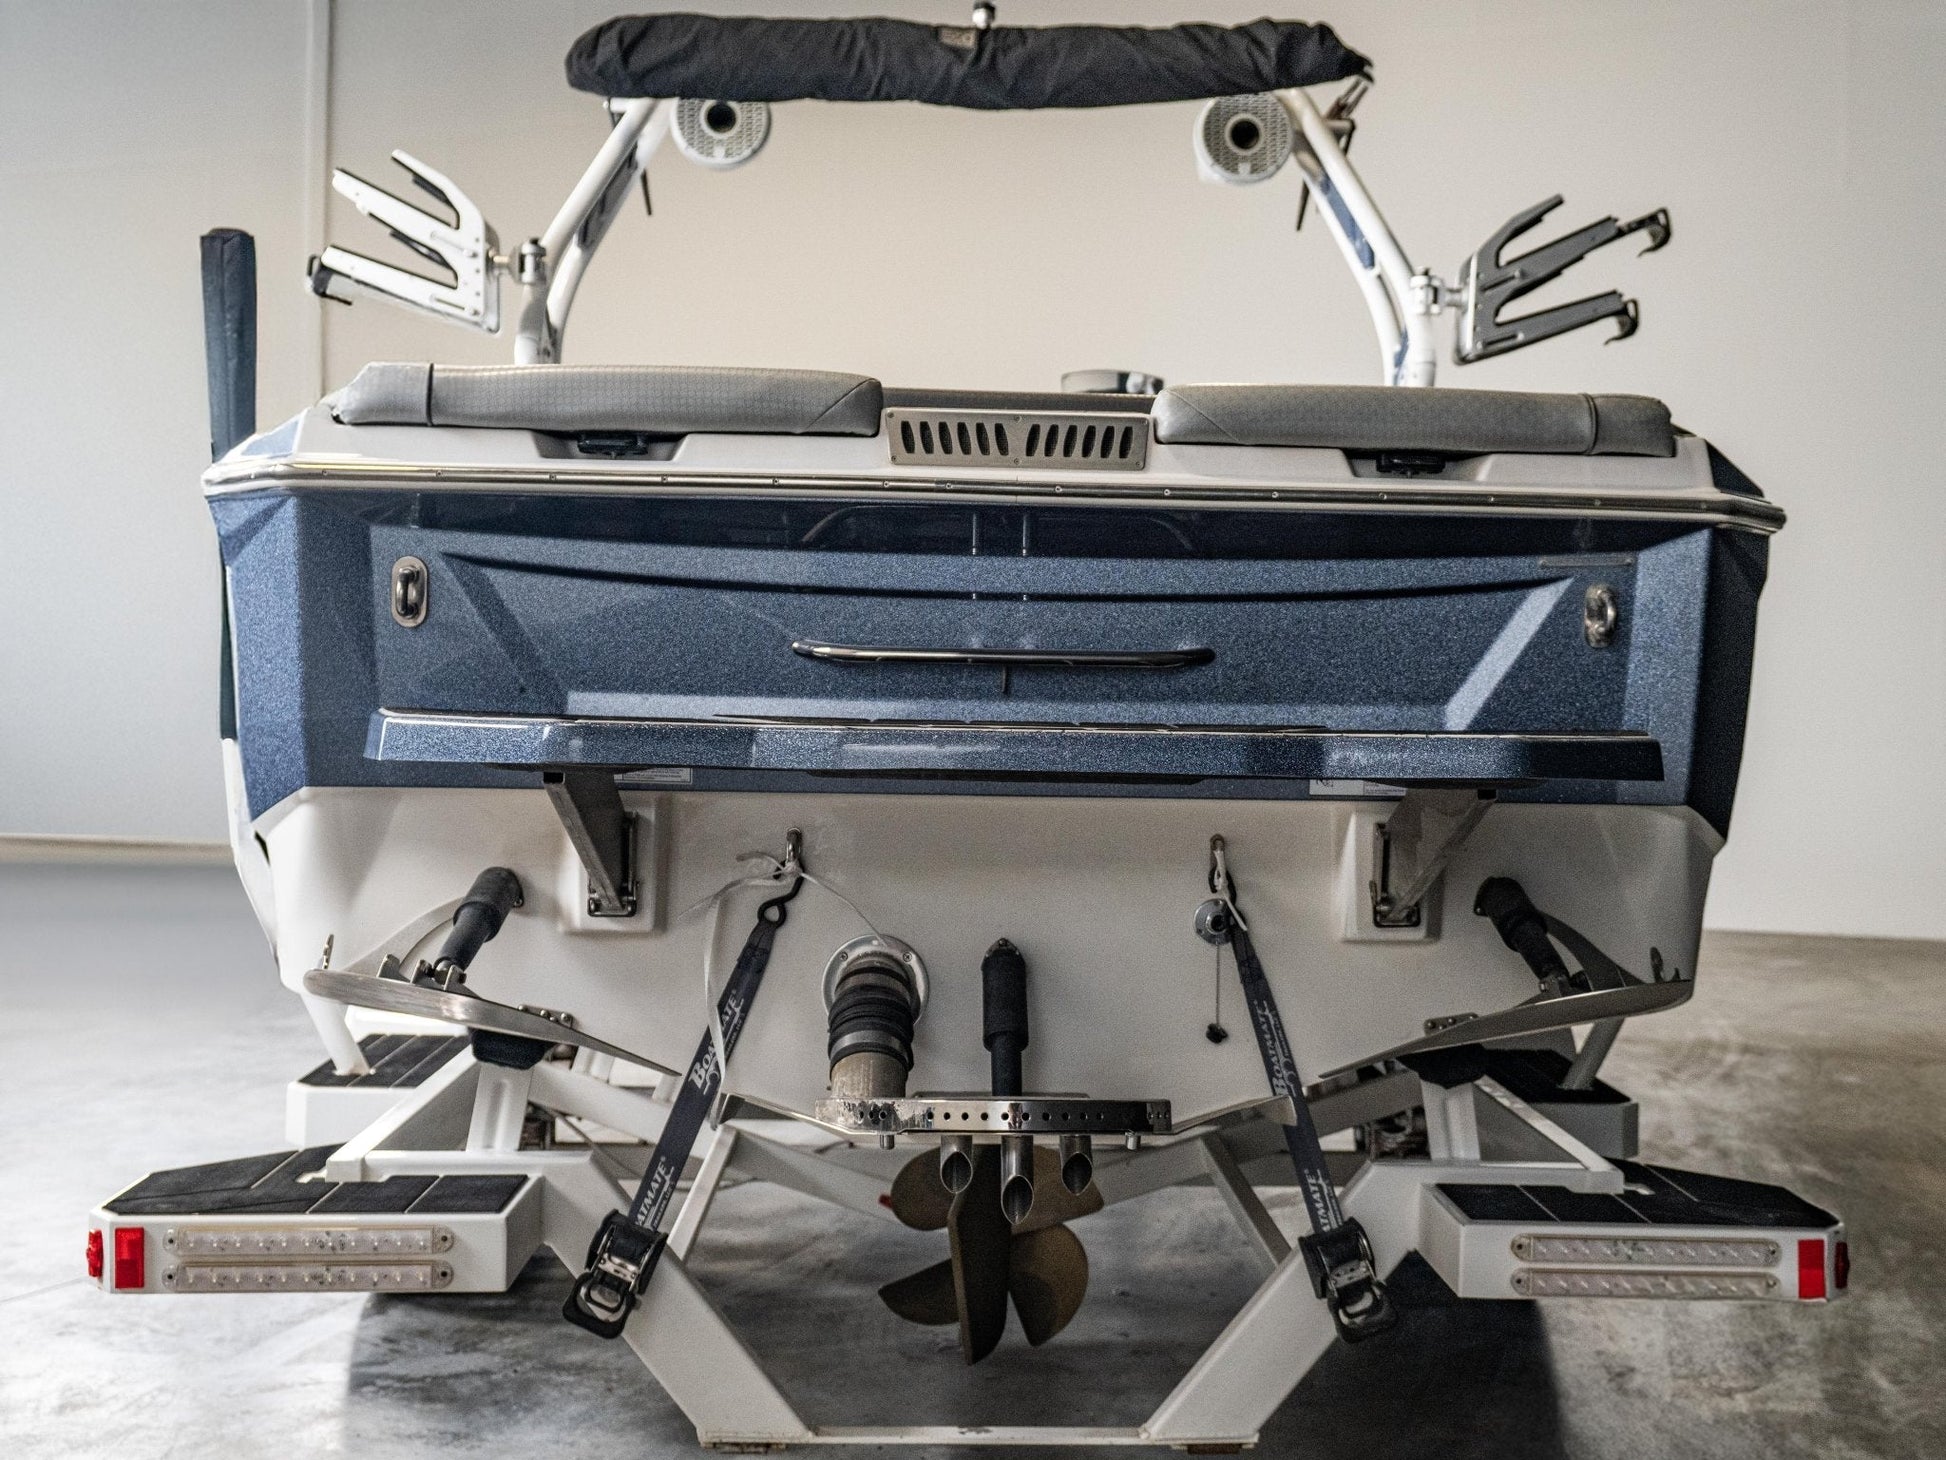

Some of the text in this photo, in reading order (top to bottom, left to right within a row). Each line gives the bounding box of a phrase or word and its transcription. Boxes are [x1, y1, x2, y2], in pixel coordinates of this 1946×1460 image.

[688, 994, 739, 1089] BOAATE
[635, 1161, 667, 1227] ATMATE
[1306, 1173, 1331, 1232] ATMATE
